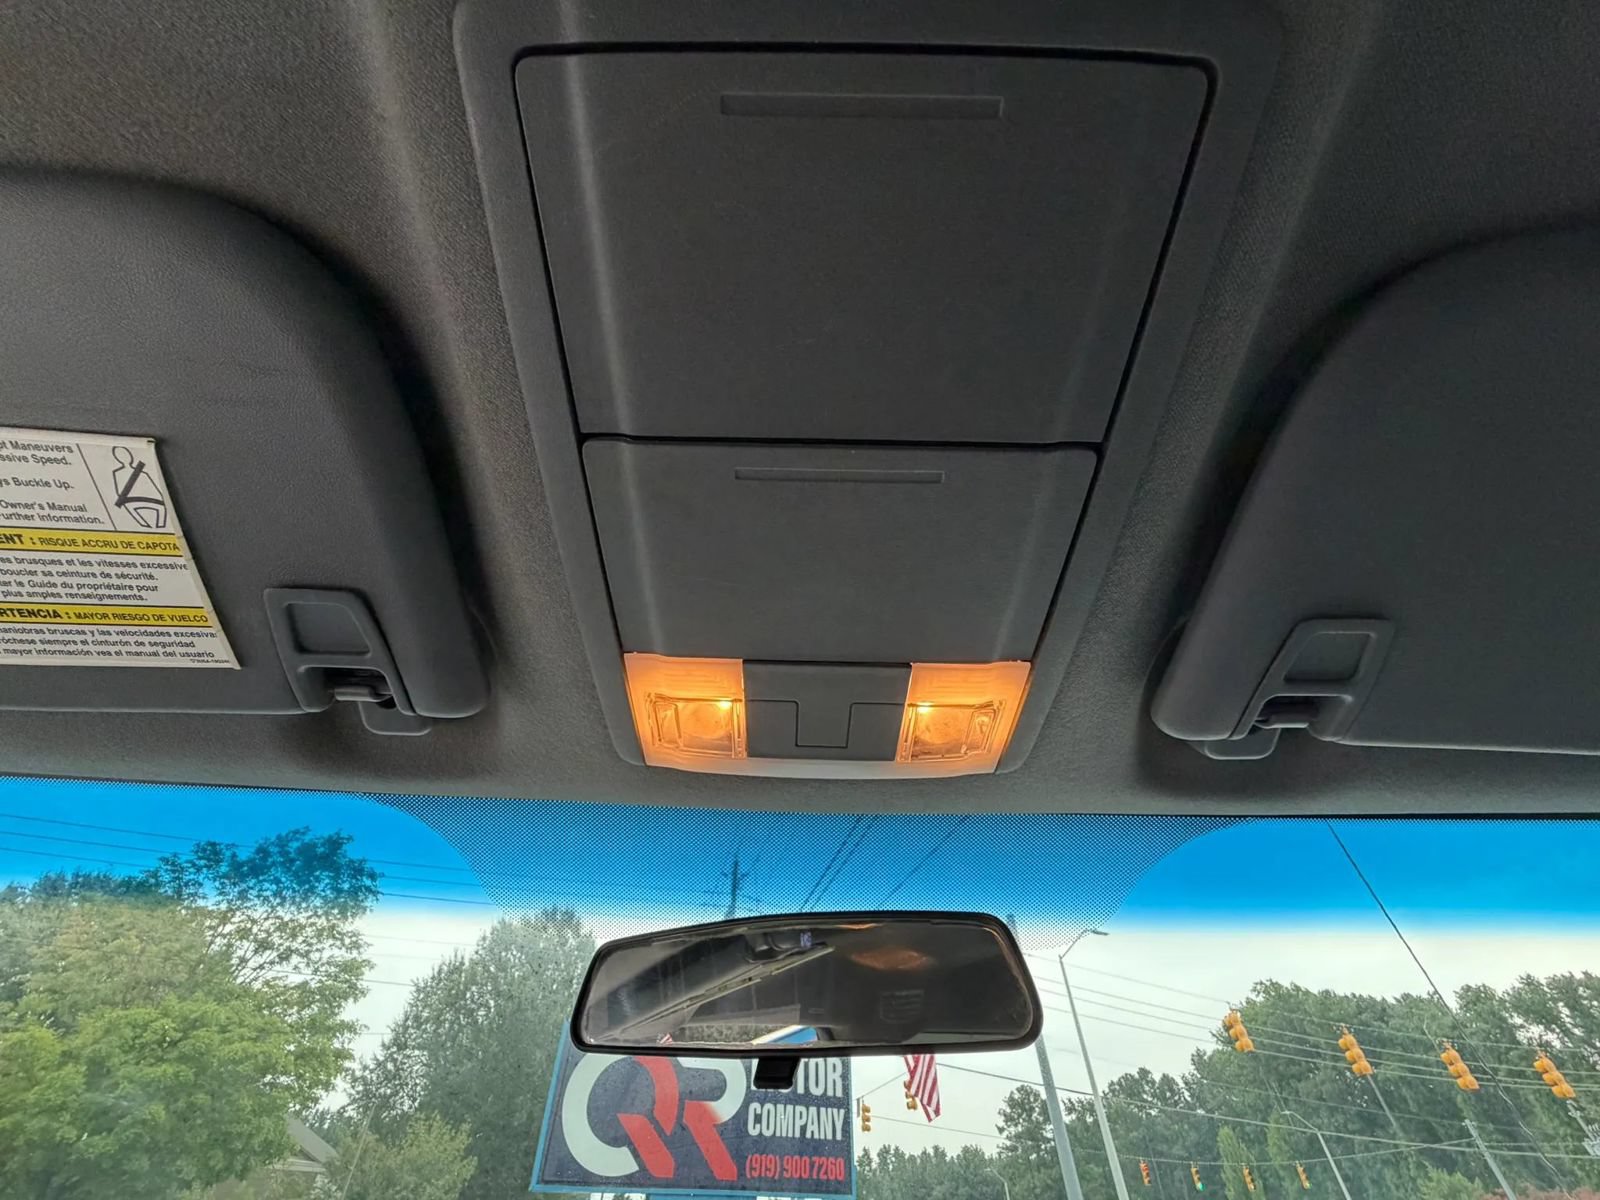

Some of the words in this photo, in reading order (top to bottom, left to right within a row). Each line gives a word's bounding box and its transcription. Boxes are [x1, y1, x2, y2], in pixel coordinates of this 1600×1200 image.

[9, 441, 74, 453] Maneuvers
[31, 454, 72, 466] Speed.
[11, 477, 52, 488] Buckle
[52, 479, 75, 490] Up.
[0, 499, 45, 511] Owner's
[46, 502, 88, 513] Manual
[0, 512, 35, 521] urther
[37, 513, 105, 524] Information.
[38, 537, 81, 547] RISQUE
[81, 538, 119, 549] ACCRU
[120, 540, 136, 549] DE
[13, 556, 65, 567] brusques
[65, 558, 76, 566] et
[77, 558, 94, 567] les
[94, 559, 138, 569] vitesses
[56, 569, 98, 579] ceinture
[99, 571, 113, 579] de
[114, 571, 159, 581] sécurité.
[28, 580, 58, 589] Guide
[60, 581, 74, 589] du
[76, 582, 134, 591] propriétaire
[135, 584, 159, 592] pour
[1, 589, 24, 598] plus
[25, 590, 63, 599] amples
[65, 592, 148, 601] renseignements.
[73, 612, 111, 620] MAYOR
[112, 613, 150, 622] RIESGO
[168, 614, 208, 623] VUELCO
[47, 627, 87, 635] bruscas
[87, 629, 95, 637] y
[96, 628, 112, 636] las
[113, 629, 172, 638] velocidades
[0, 637, 37, 645] óchese
[39, 638, 78, 647] siempre
[91, 639, 132, 647] cinturón
[149, 640, 195, 649] seguridad
[3, 648, 33, 656] mayor
[34, 647, 94, 656] información
[162, 650, 177, 658] del
[751, 1058, 843, 1097] TOR
[748, 1102, 845, 1141] COMPANY
[746, 1153, 779, 1180] (919)
[783, 1155, 810, 1179] 900
[812, 1157, 845, 1181] 7260
